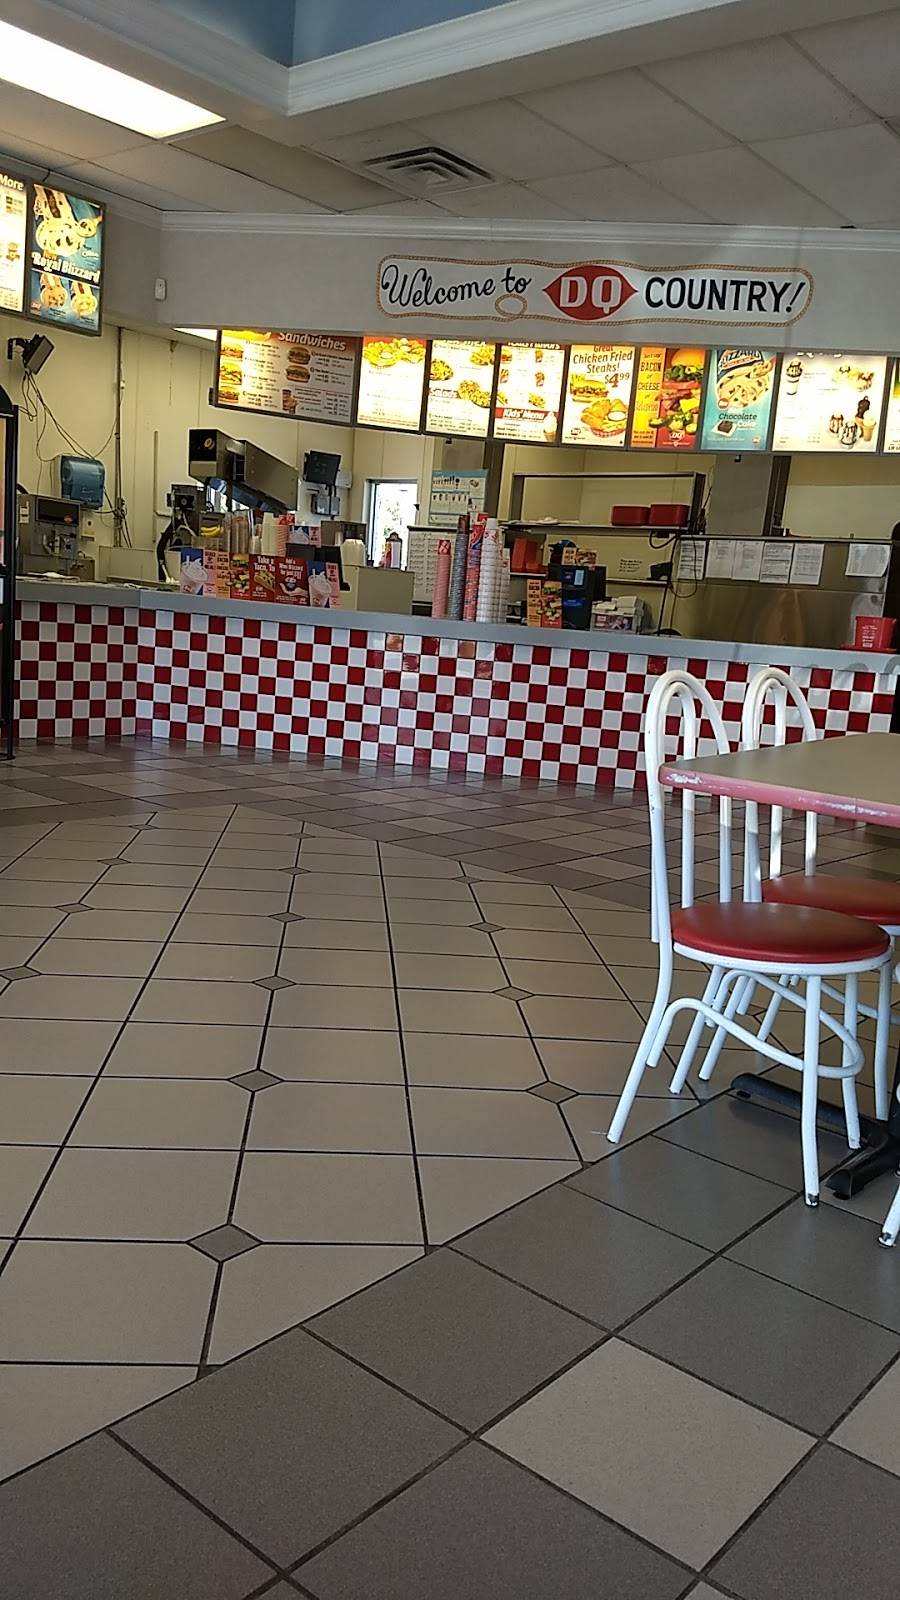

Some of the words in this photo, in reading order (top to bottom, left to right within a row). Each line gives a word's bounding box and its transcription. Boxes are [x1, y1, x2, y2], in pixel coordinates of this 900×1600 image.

[32, 252, 62, 272] Royal
[61, 260, 100, 283] Blizzard
[381, 264, 496, 307] Welcome
[501, 267, 532, 293] to
[559, 276, 623, 314] DQ
[645, 277, 806, 313] COUNTRY!
[573, 353, 608, 365] Chicken
[610, 350, 633, 361] Fried
[640, 362, 662, 372] BACON
[638, 382, 660, 390] CHEESE
[718, 412, 758, 421] Chocolate
